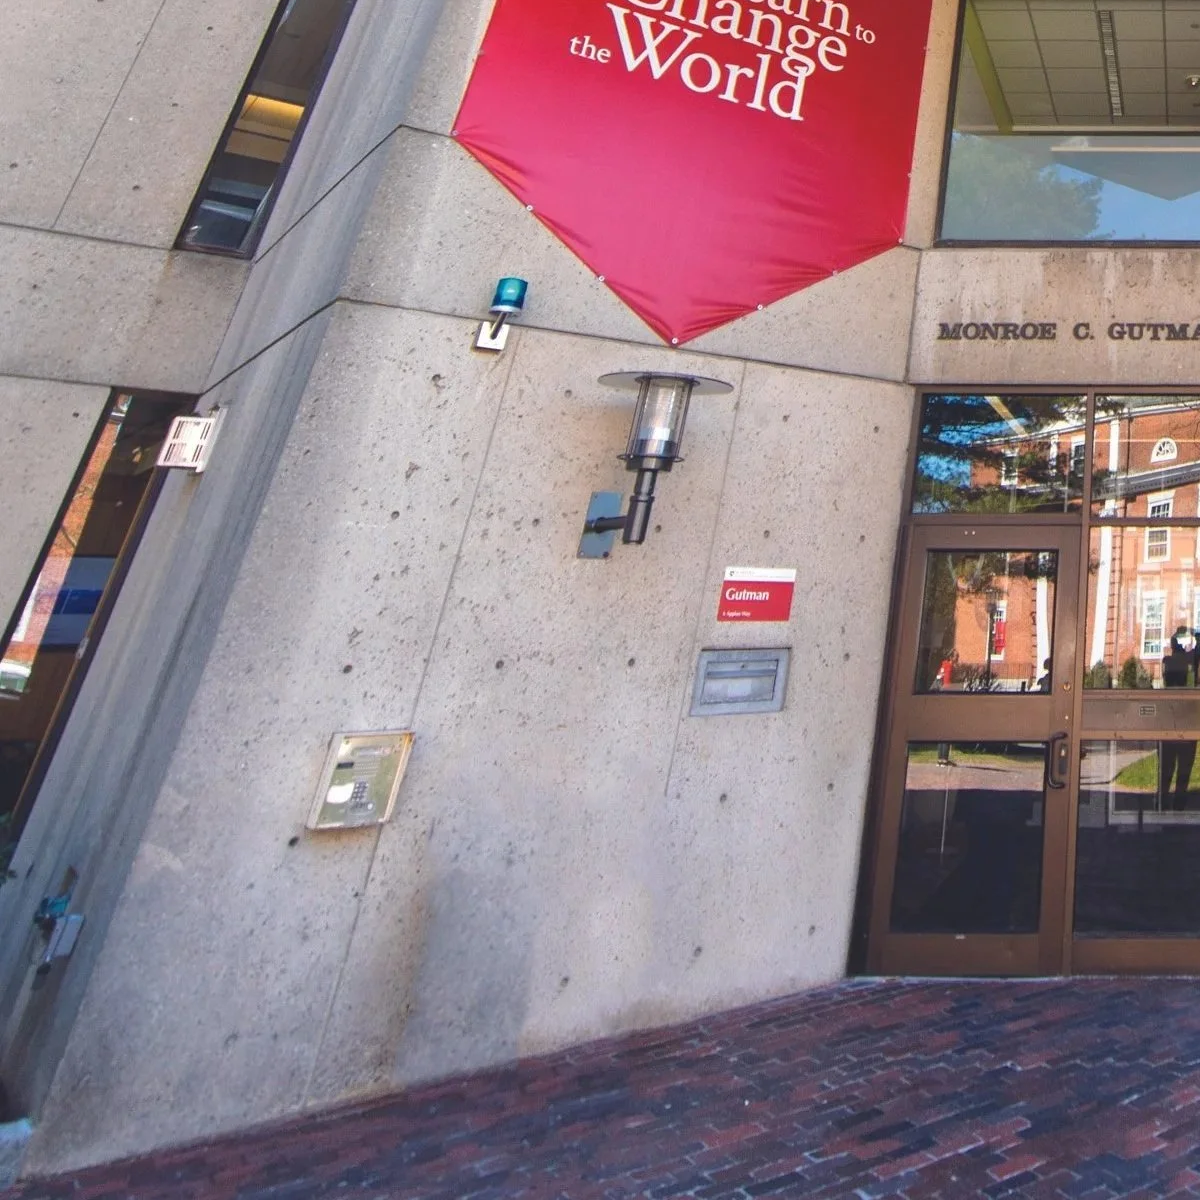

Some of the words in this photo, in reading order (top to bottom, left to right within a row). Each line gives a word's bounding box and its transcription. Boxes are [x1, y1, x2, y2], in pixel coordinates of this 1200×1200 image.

[854, 22, 877, 44] to
[568, 35, 612, 64] the
[607, 3, 804, 121] World
[938, 322, 1057, 341] MONROE
[1073, 322, 1095, 341] C.
[725, 587, 769, 601] Gutman
